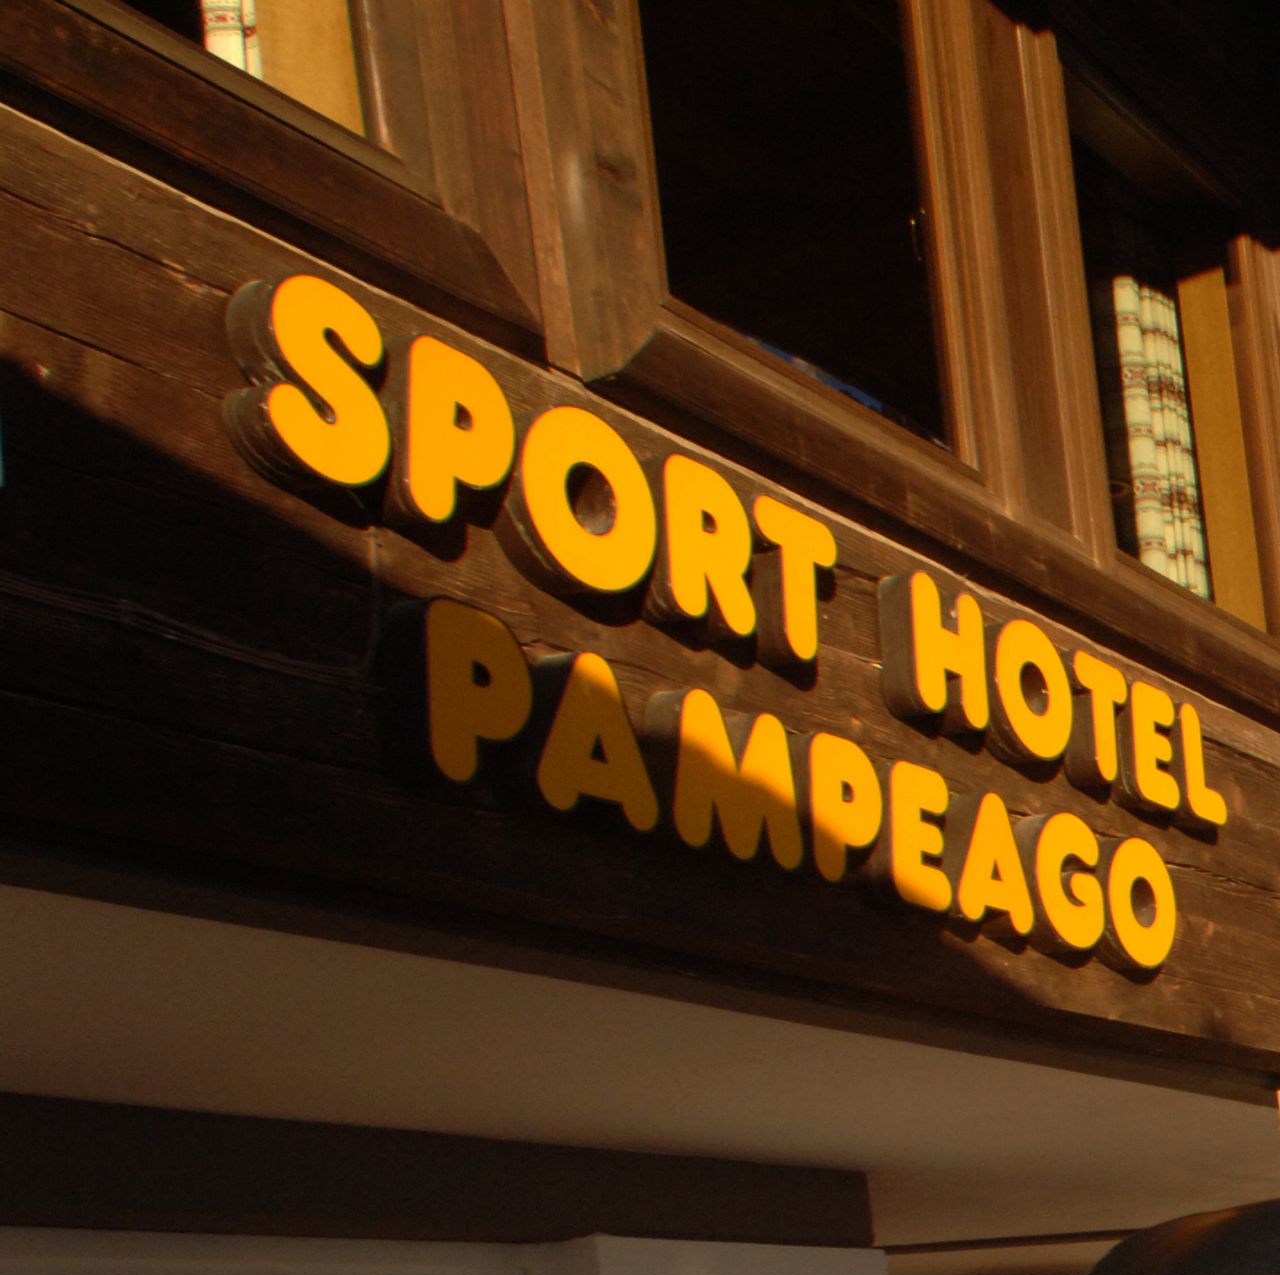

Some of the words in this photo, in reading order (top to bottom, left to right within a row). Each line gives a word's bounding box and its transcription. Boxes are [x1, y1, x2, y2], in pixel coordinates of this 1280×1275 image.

[266, 273, 837, 662] SPORT
[908, 569, 1228, 826] HOTEL
[424, 599, 1178, 969] PAMPEAGO
